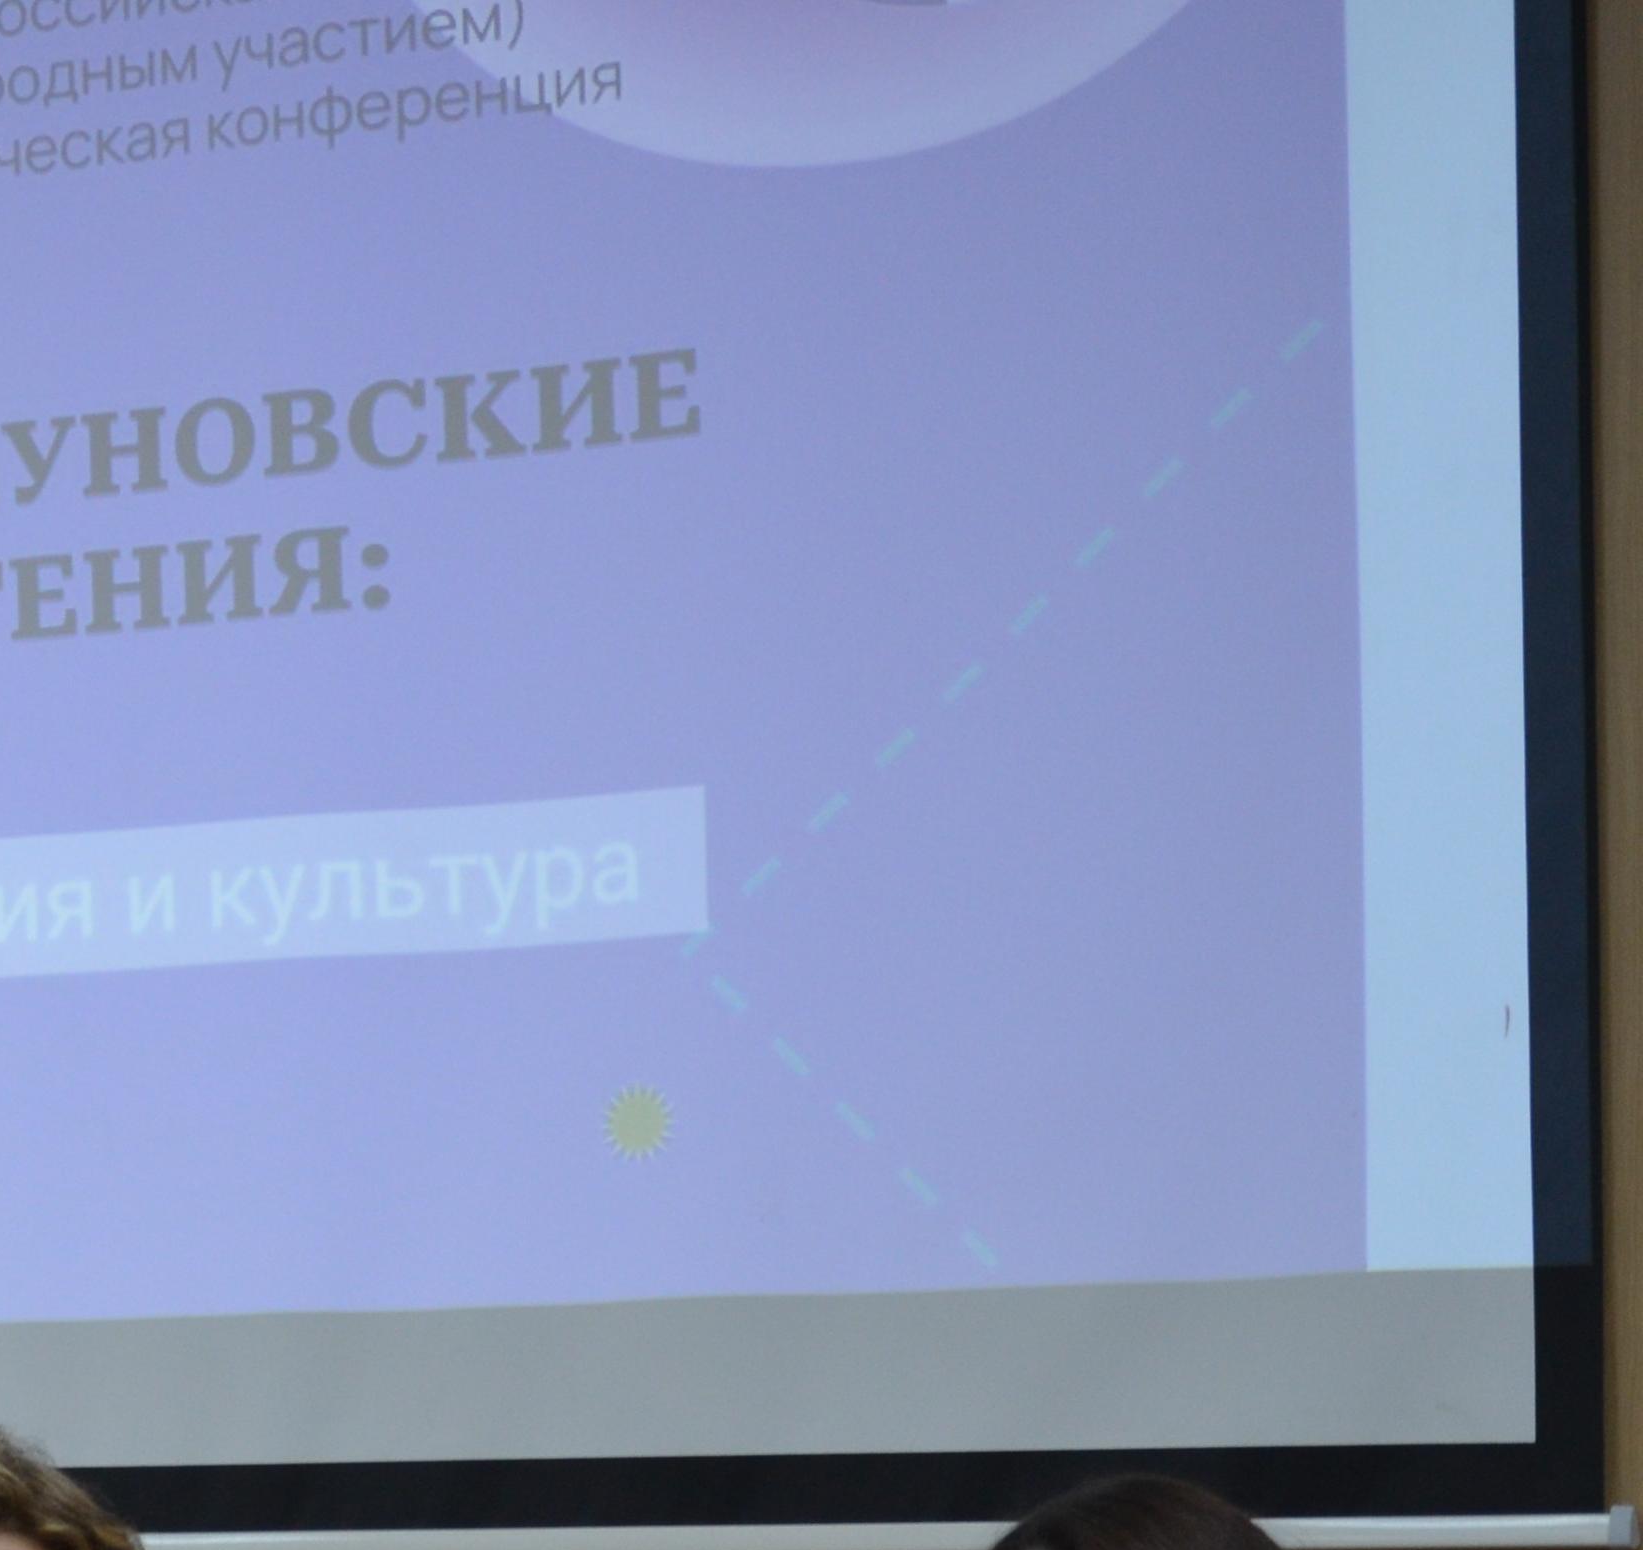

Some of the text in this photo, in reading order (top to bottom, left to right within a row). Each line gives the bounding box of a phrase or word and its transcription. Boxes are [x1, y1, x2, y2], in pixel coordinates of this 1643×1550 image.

[213, 2, 524, 92] участием)
[207, 60, 623, 150] конференция
[129, 870, 178, 934] и
[210, 838, 642, 945] культура
